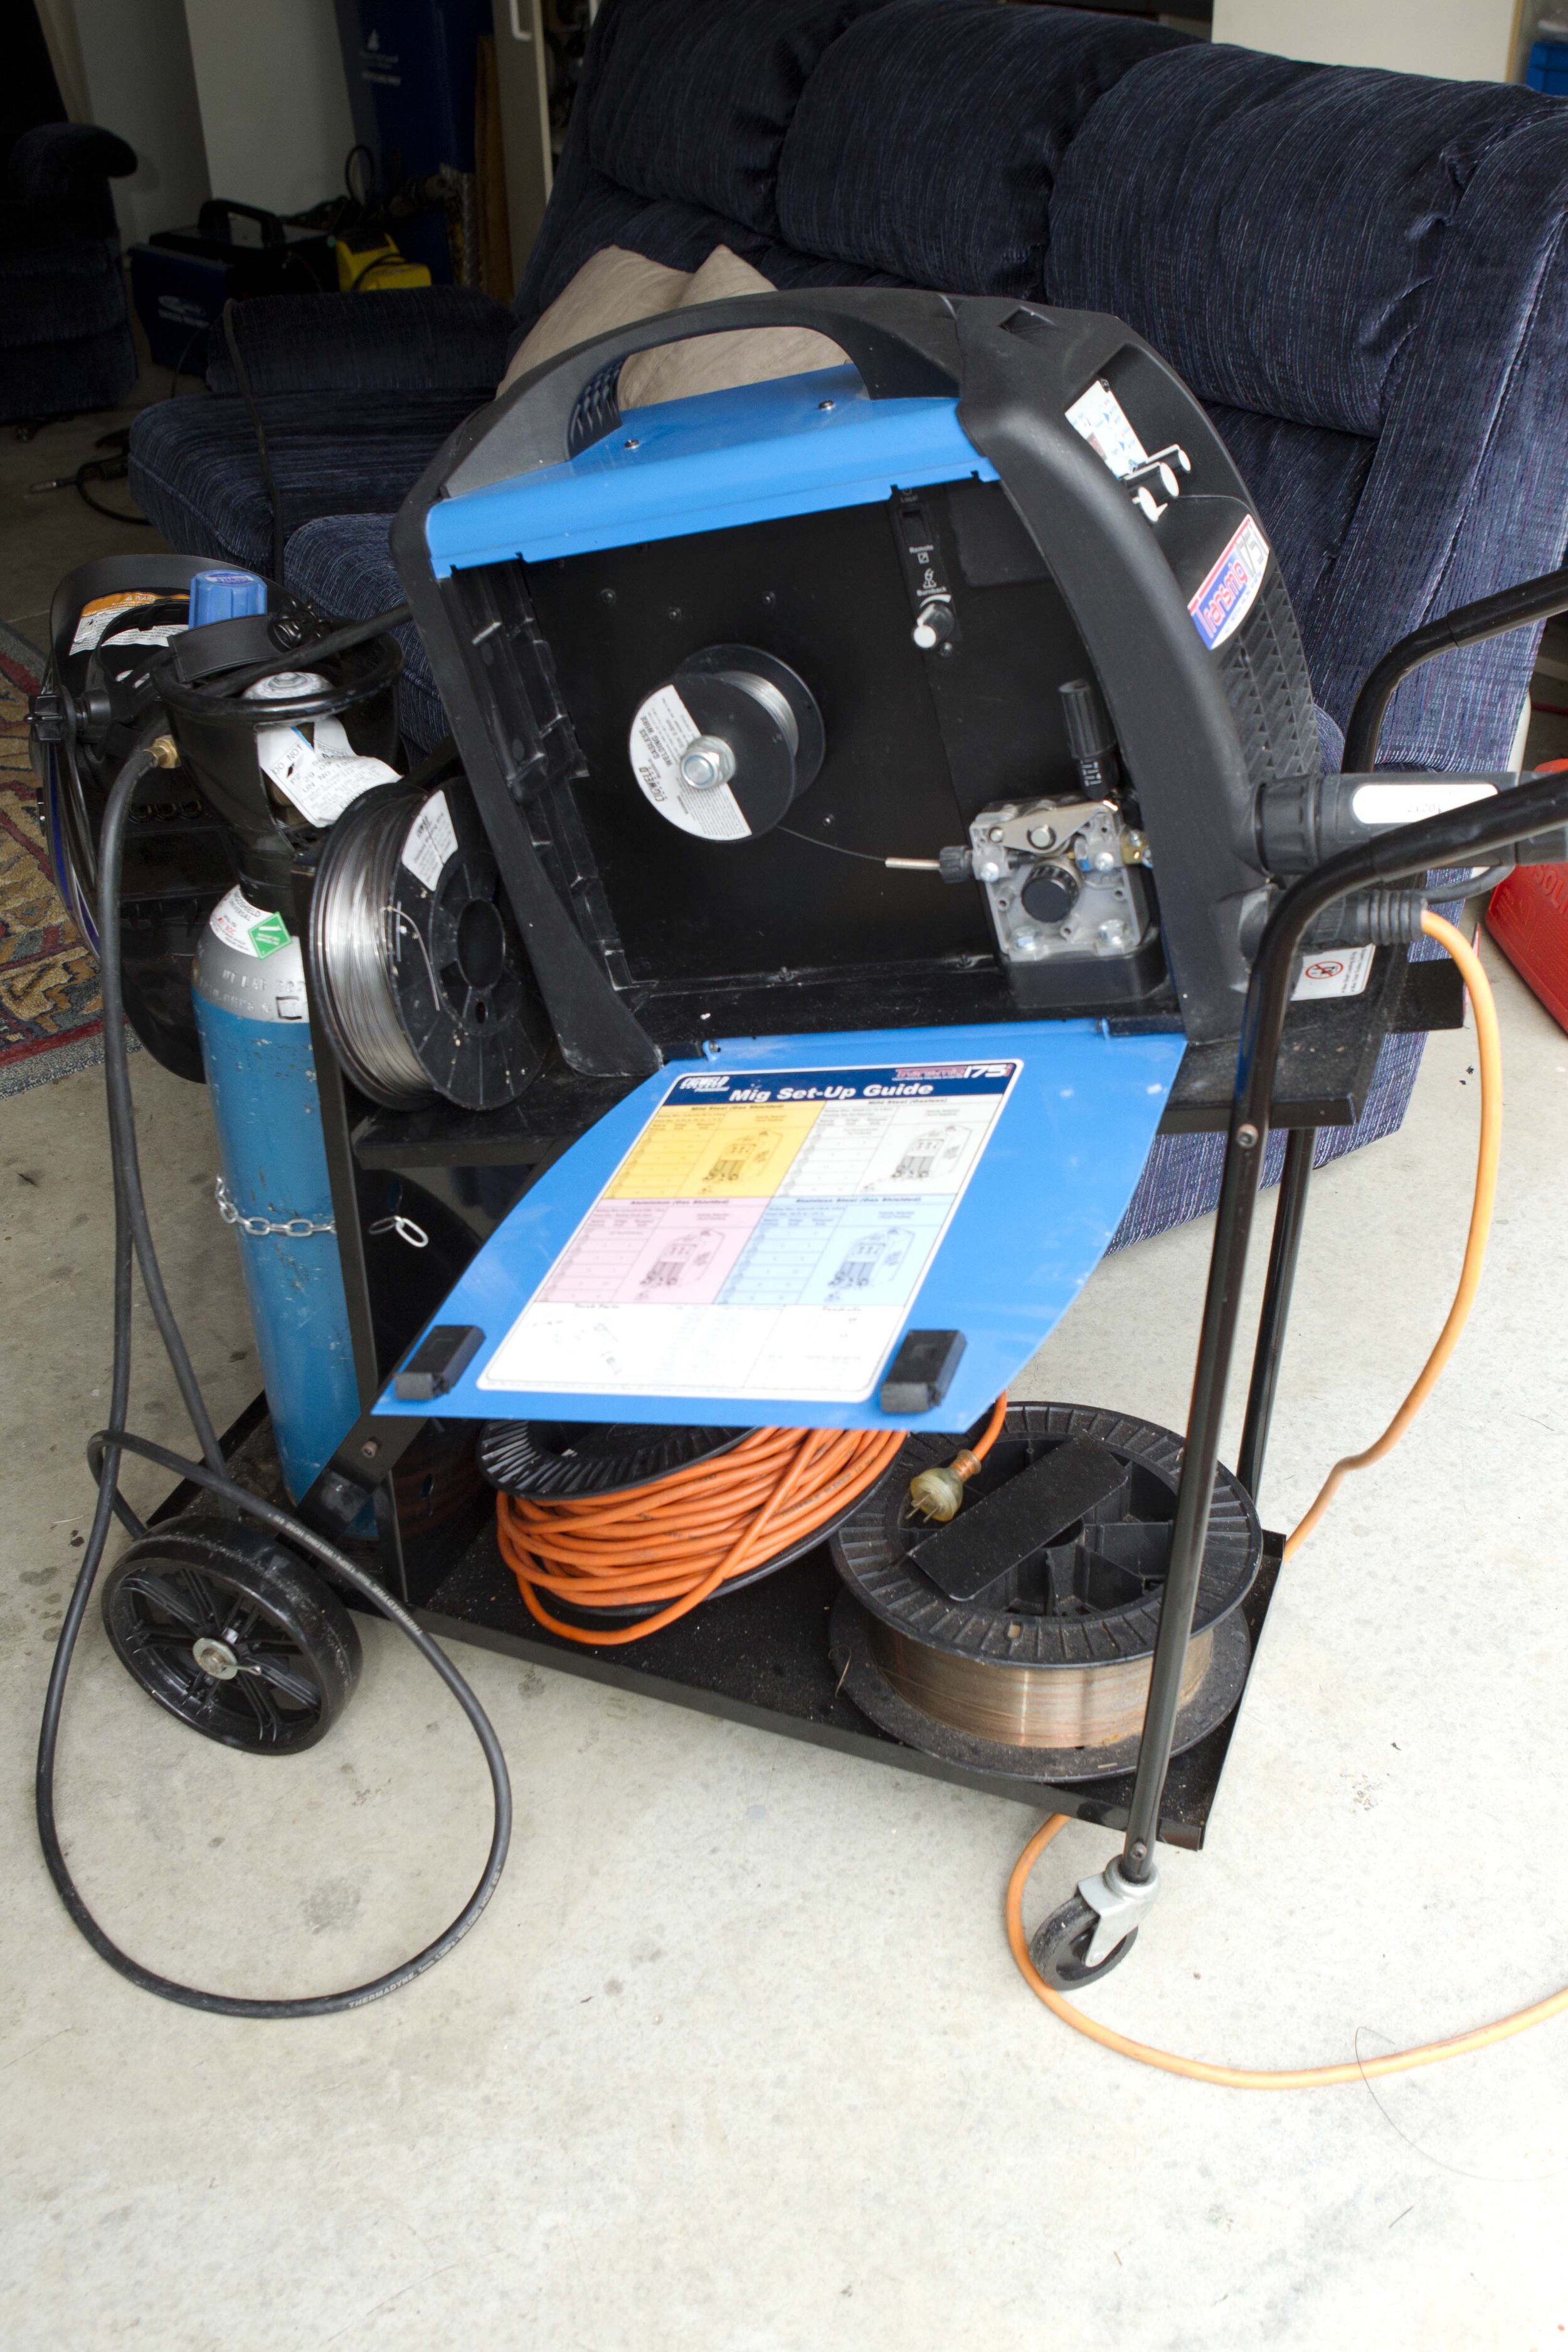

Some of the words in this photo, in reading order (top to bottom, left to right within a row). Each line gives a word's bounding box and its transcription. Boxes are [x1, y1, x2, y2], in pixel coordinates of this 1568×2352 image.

[640, 716, 654, 734] WIRE
[638, 728, 661, 760] GASLESS
[652, 733, 673, 767] WELDING
[272, 763, 285, 775] DO
[287, 743, 304, 763] NOT
[963, 1064, 1014, 1079] 175i
[729, 1089, 771, 1103] Mig
[776, 1085, 857, 1101] Set-Up
[863, 1083, 934, 1097] Guide
[285, 1521, 305, 1537] HOSE
[305, 1534, 334, 1557] WELDING
